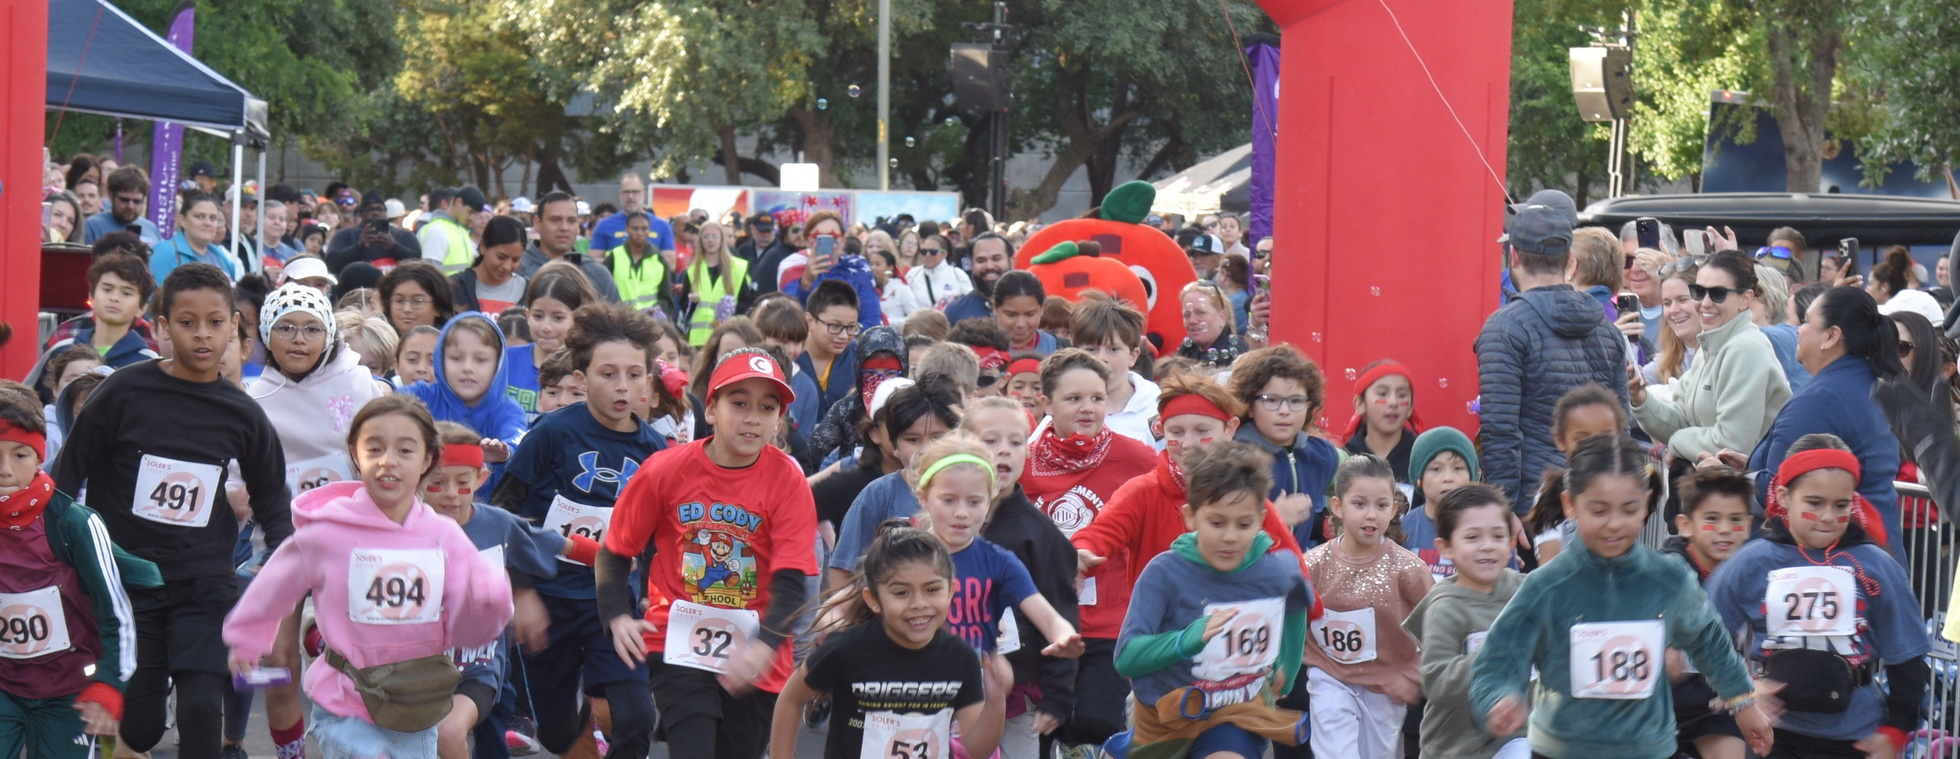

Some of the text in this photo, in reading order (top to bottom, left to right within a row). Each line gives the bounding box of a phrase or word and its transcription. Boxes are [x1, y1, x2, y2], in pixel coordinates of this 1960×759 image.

[754, 359, 766, 371] C
[146, 460, 172, 470] SOLER'S
[149, 482, 199, 512] 491
[677, 502, 763, 533] ED CODY
[366, 577, 425, 607] 494
[1783, 591, 1838, 621] 275
[675, 604, 702, 617] SOLER'S
[693, 627, 732, 660] 32
[1222, 624, 1269, 659] 169
[1320, 626, 1362, 653] 186
[1589, 649, 1649, 683] 188
[871, 715, 900, 727] SOLER'S
[891, 740, 928, 759] 53
